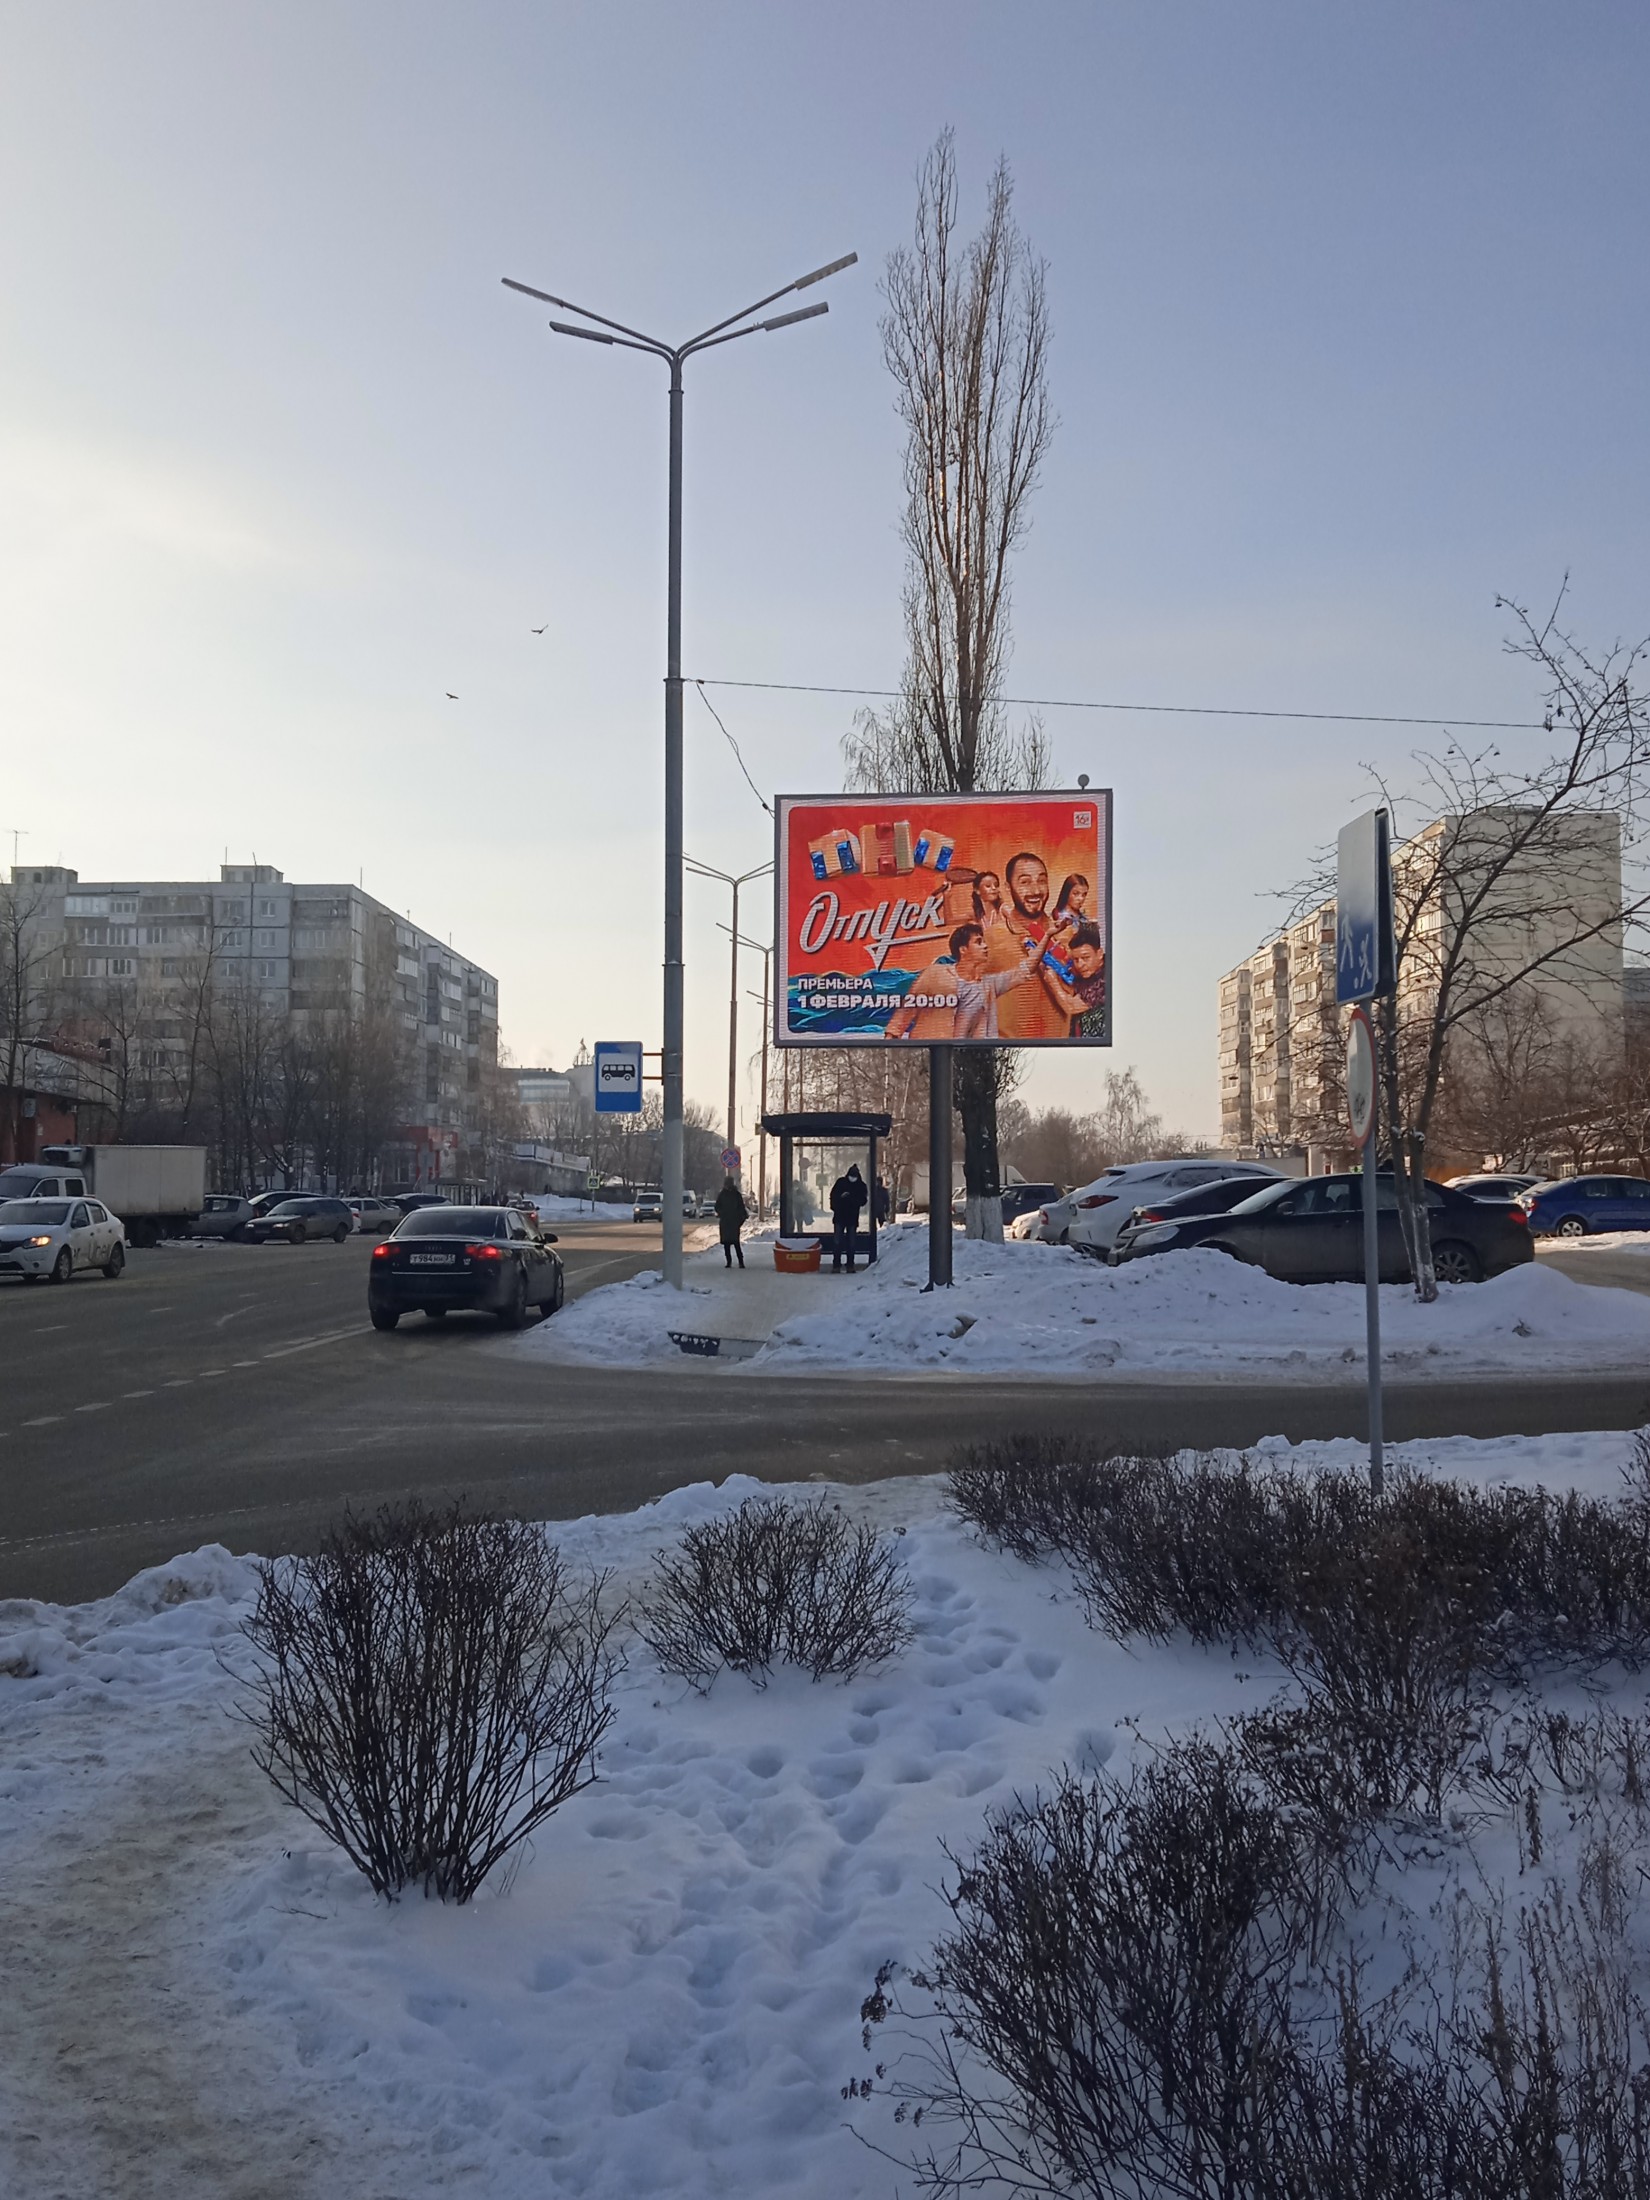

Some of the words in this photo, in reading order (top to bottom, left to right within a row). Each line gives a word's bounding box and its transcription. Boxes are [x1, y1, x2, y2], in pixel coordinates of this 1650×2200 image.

[808, 820, 956, 880] ТНТ
[799, 891, 950, 971] Отпуск
[797, 977, 873, 990] ПРЕМЬЕРА
[797, 994, 807, 1008] 1
[809, 993, 900, 1008] ФЕВРАЛЯ
[903, 993, 958, 1008] 20:00
